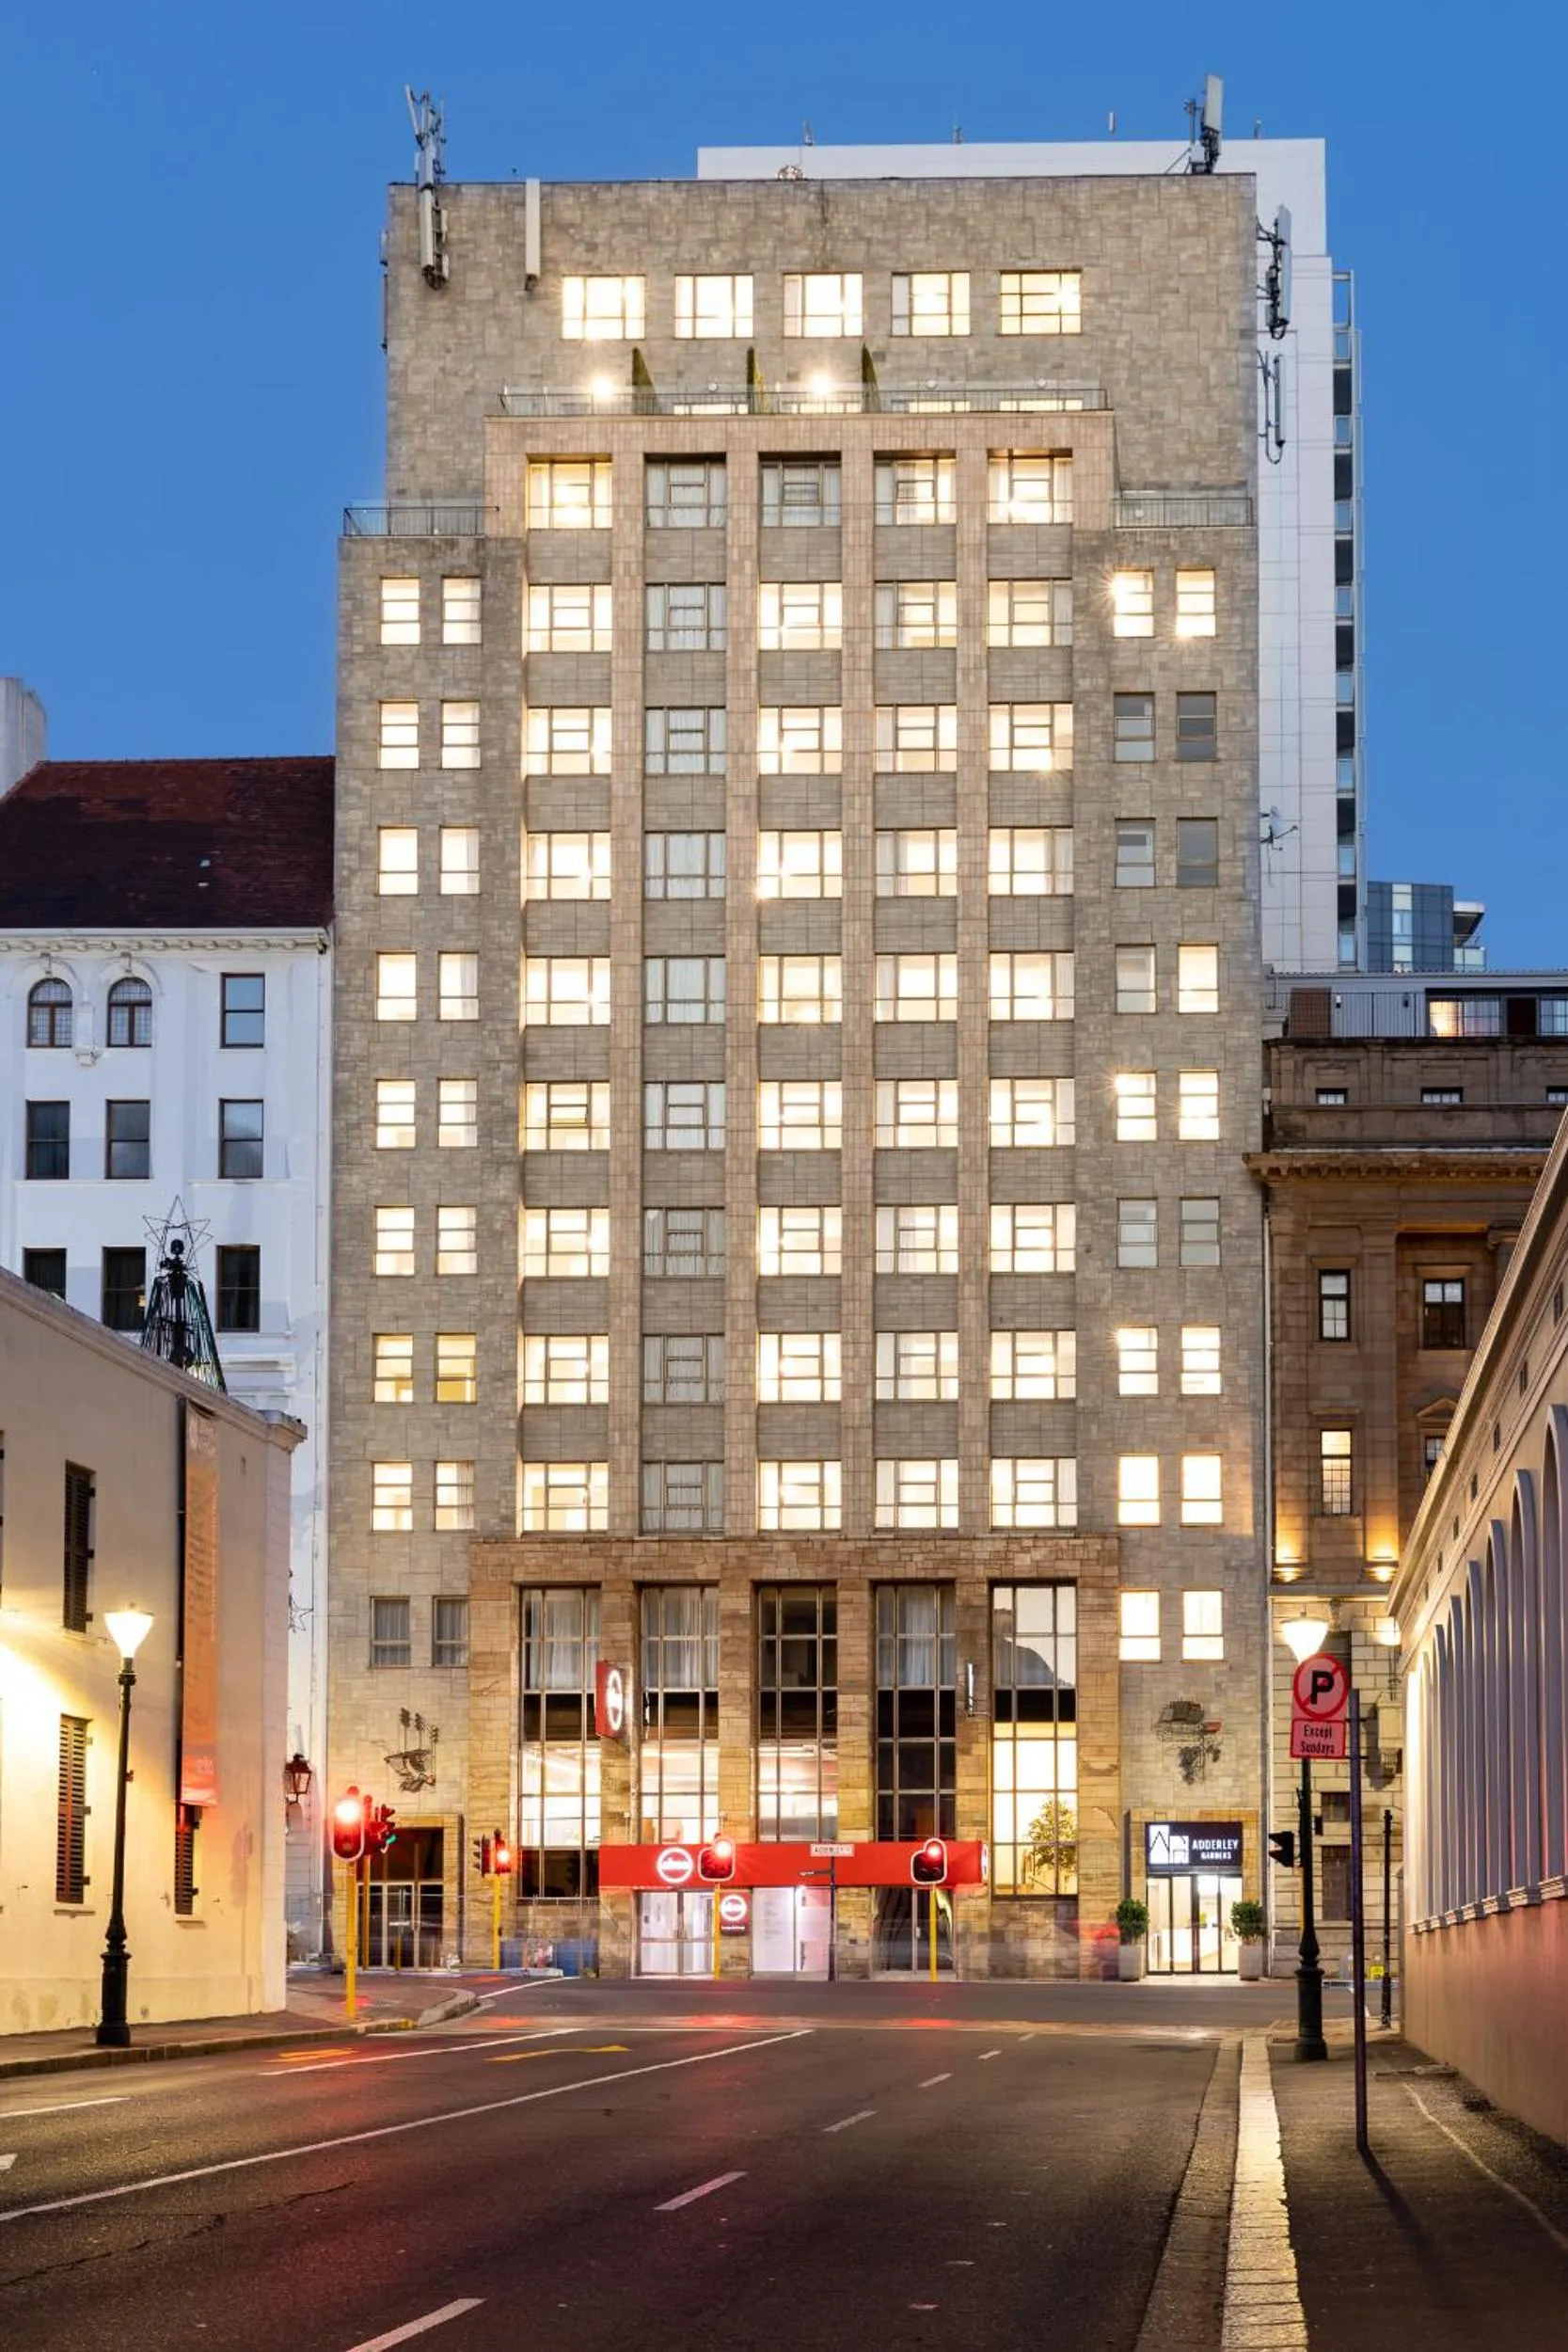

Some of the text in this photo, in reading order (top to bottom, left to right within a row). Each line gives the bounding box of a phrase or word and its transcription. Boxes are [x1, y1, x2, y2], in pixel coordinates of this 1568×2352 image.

[1310, 1669, 1335, 1705] P
[1304, 1724, 1333, 1740] Except
[1300, 1740, 1336, 1756] Sundays
[1192, 1838, 1239, 1851] ADDERLEY
